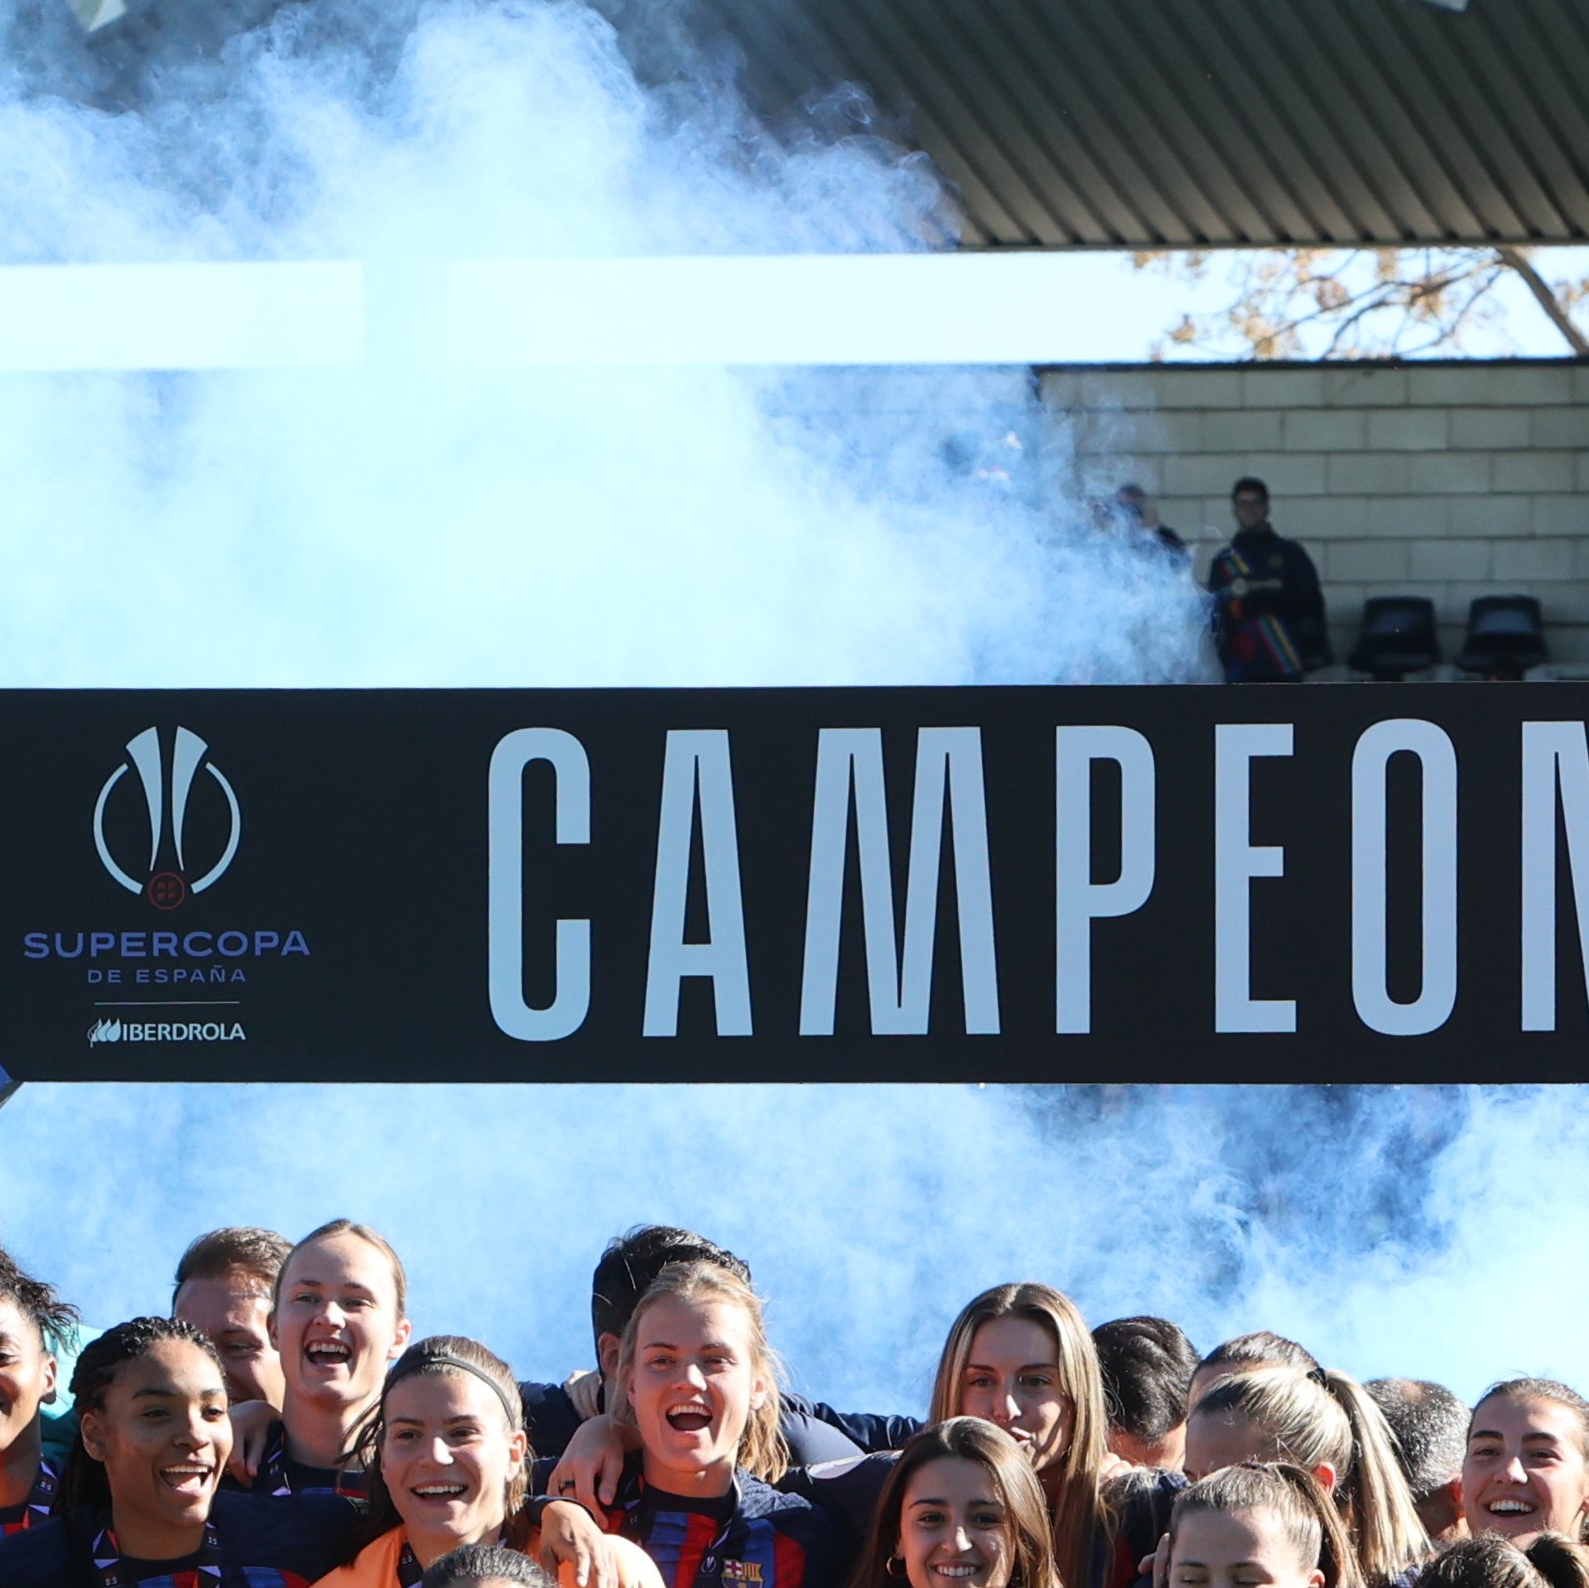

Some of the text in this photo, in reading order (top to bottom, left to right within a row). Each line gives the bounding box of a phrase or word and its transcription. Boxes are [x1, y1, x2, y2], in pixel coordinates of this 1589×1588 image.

[23, 930, 311, 960] SUPERCOPA
[87, 964, 247, 984] DE ESPAÑA
[122, 1022, 246, 1042] IBERDROLA
